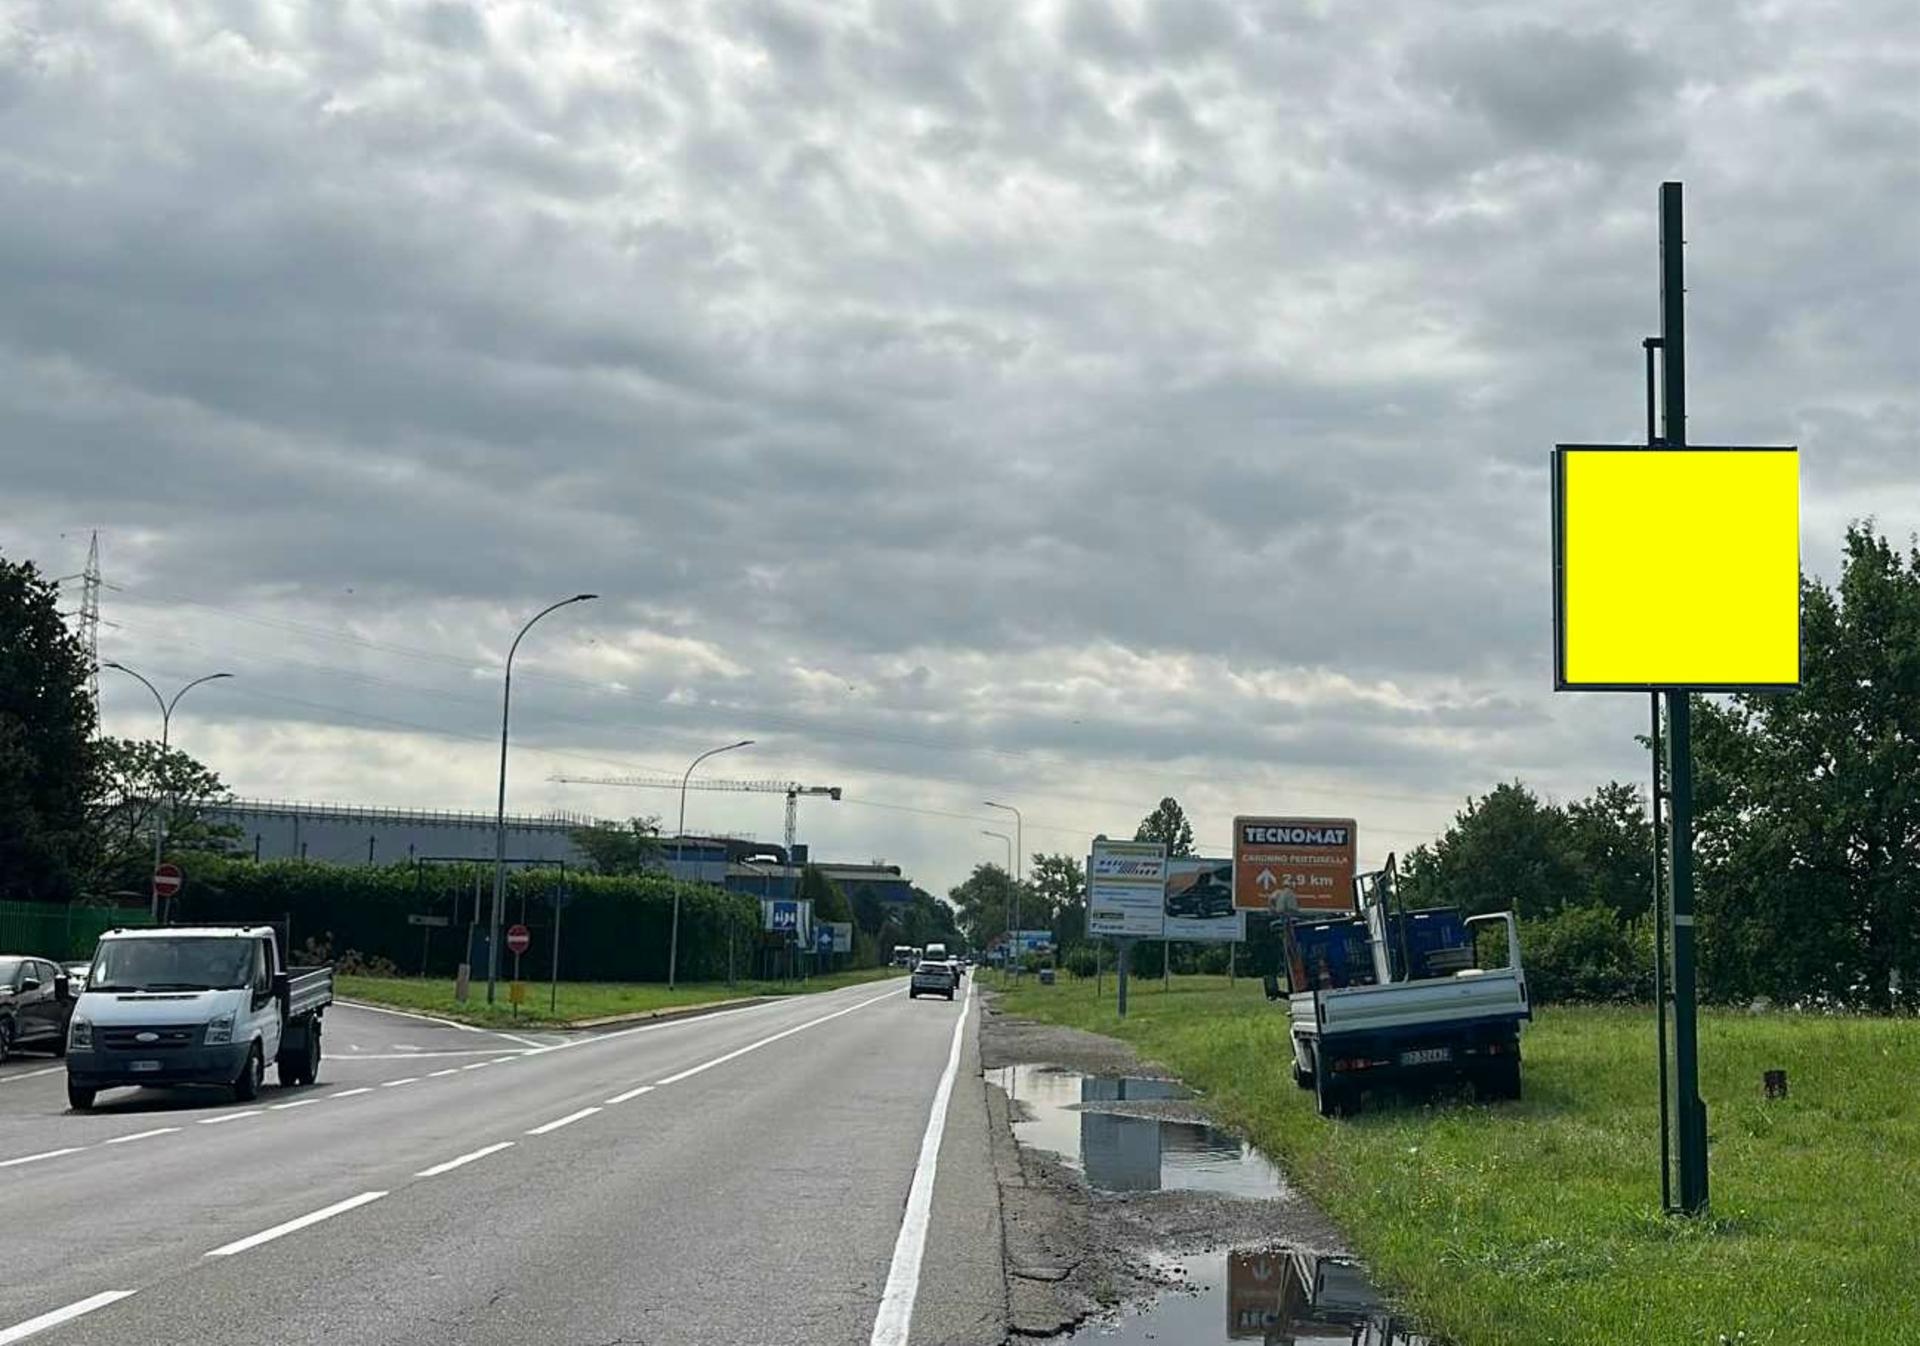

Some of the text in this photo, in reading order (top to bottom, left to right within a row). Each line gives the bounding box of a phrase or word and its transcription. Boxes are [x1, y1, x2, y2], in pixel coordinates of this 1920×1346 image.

[1246, 827, 1345, 844] TECNOMAT
[1282, 873, 1333, 888] 2,9 km
